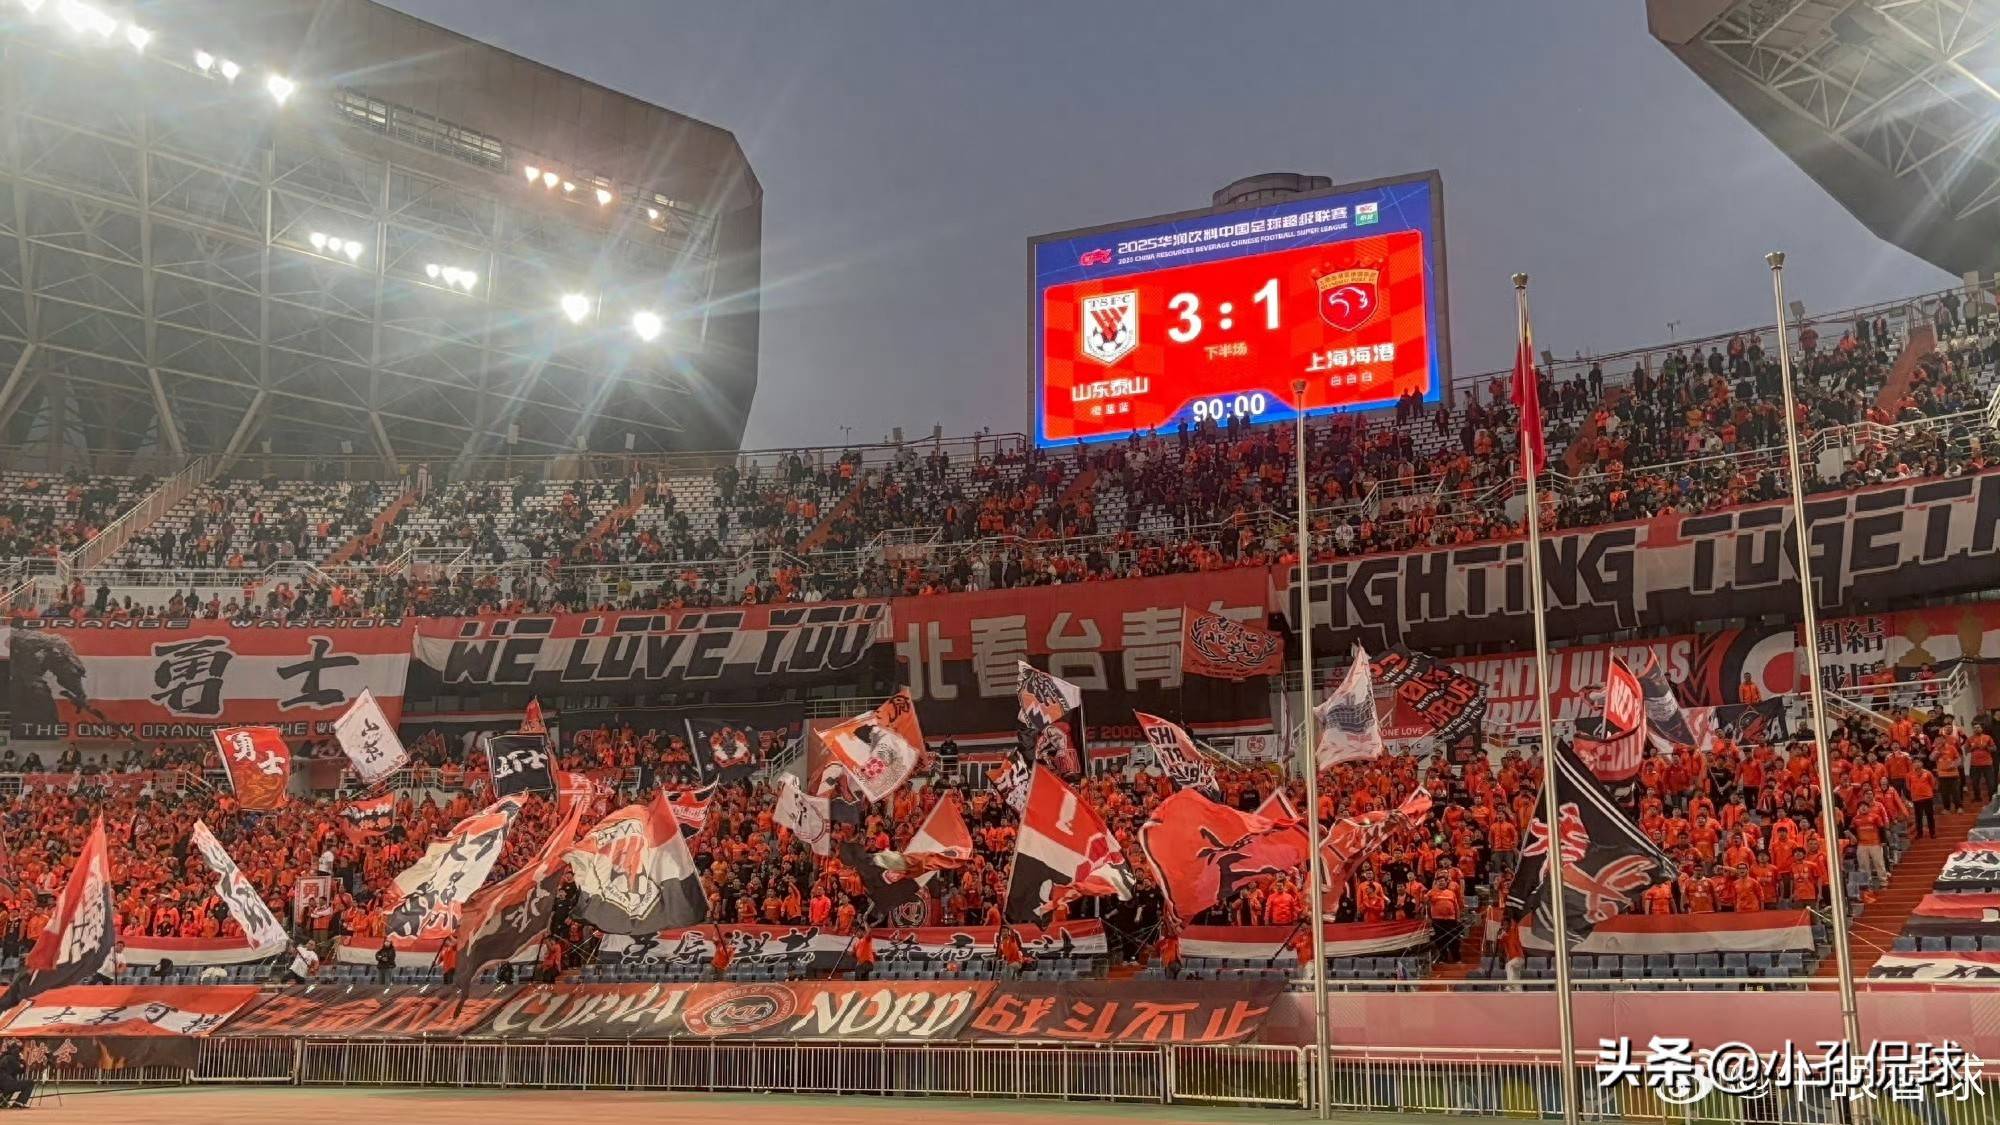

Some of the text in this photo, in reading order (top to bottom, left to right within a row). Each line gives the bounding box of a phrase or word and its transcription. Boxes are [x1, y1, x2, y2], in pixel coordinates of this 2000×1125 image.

[1117, 206, 1348, 254] 2025华润饮料中国足球超级联赛
[1135, 254, 1155, 262] CHINA
[1156, 247, 1194, 259] RESOURCES
[1195, 241, 1230, 253] BEVERAGE
[1231, 236, 1260, 247] CHINESE
[1261, 231, 1294, 242] FOOTBALL
[1296, 227, 1320, 237] SUPER
[1321, 222, 1348, 233] LEAGUE
[1089, 294, 1130, 308] TSFC
[1167, 292, 1203, 343] 3
[1253, 277, 1280, 331] 1
[1203, 341, 1248, 360] 下半场
[1305, 343, 1395, 372] 上海海港
[1071, 376, 1149, 402] 山东泰山
[1192, 393, 1266, 423] 90:00
[1288, 528, 1640, 648] FIGHTING
[22, 618, 403, 629] ORANGE WARRIOR
[443, 603, 887, 685] WE LOVE YOU
[151, 635, 361, 718] 勇士
[21, 722, 68, 736] THE
[78, 722, 134, 737] ONLY
[1382, 726, 1423, 738] ONE LOVE
[493, 983, 688, 1032] CURVA
[791, 990, 973, 1037] NORD
[971, 995, 1270, 1042] 战斗不止
